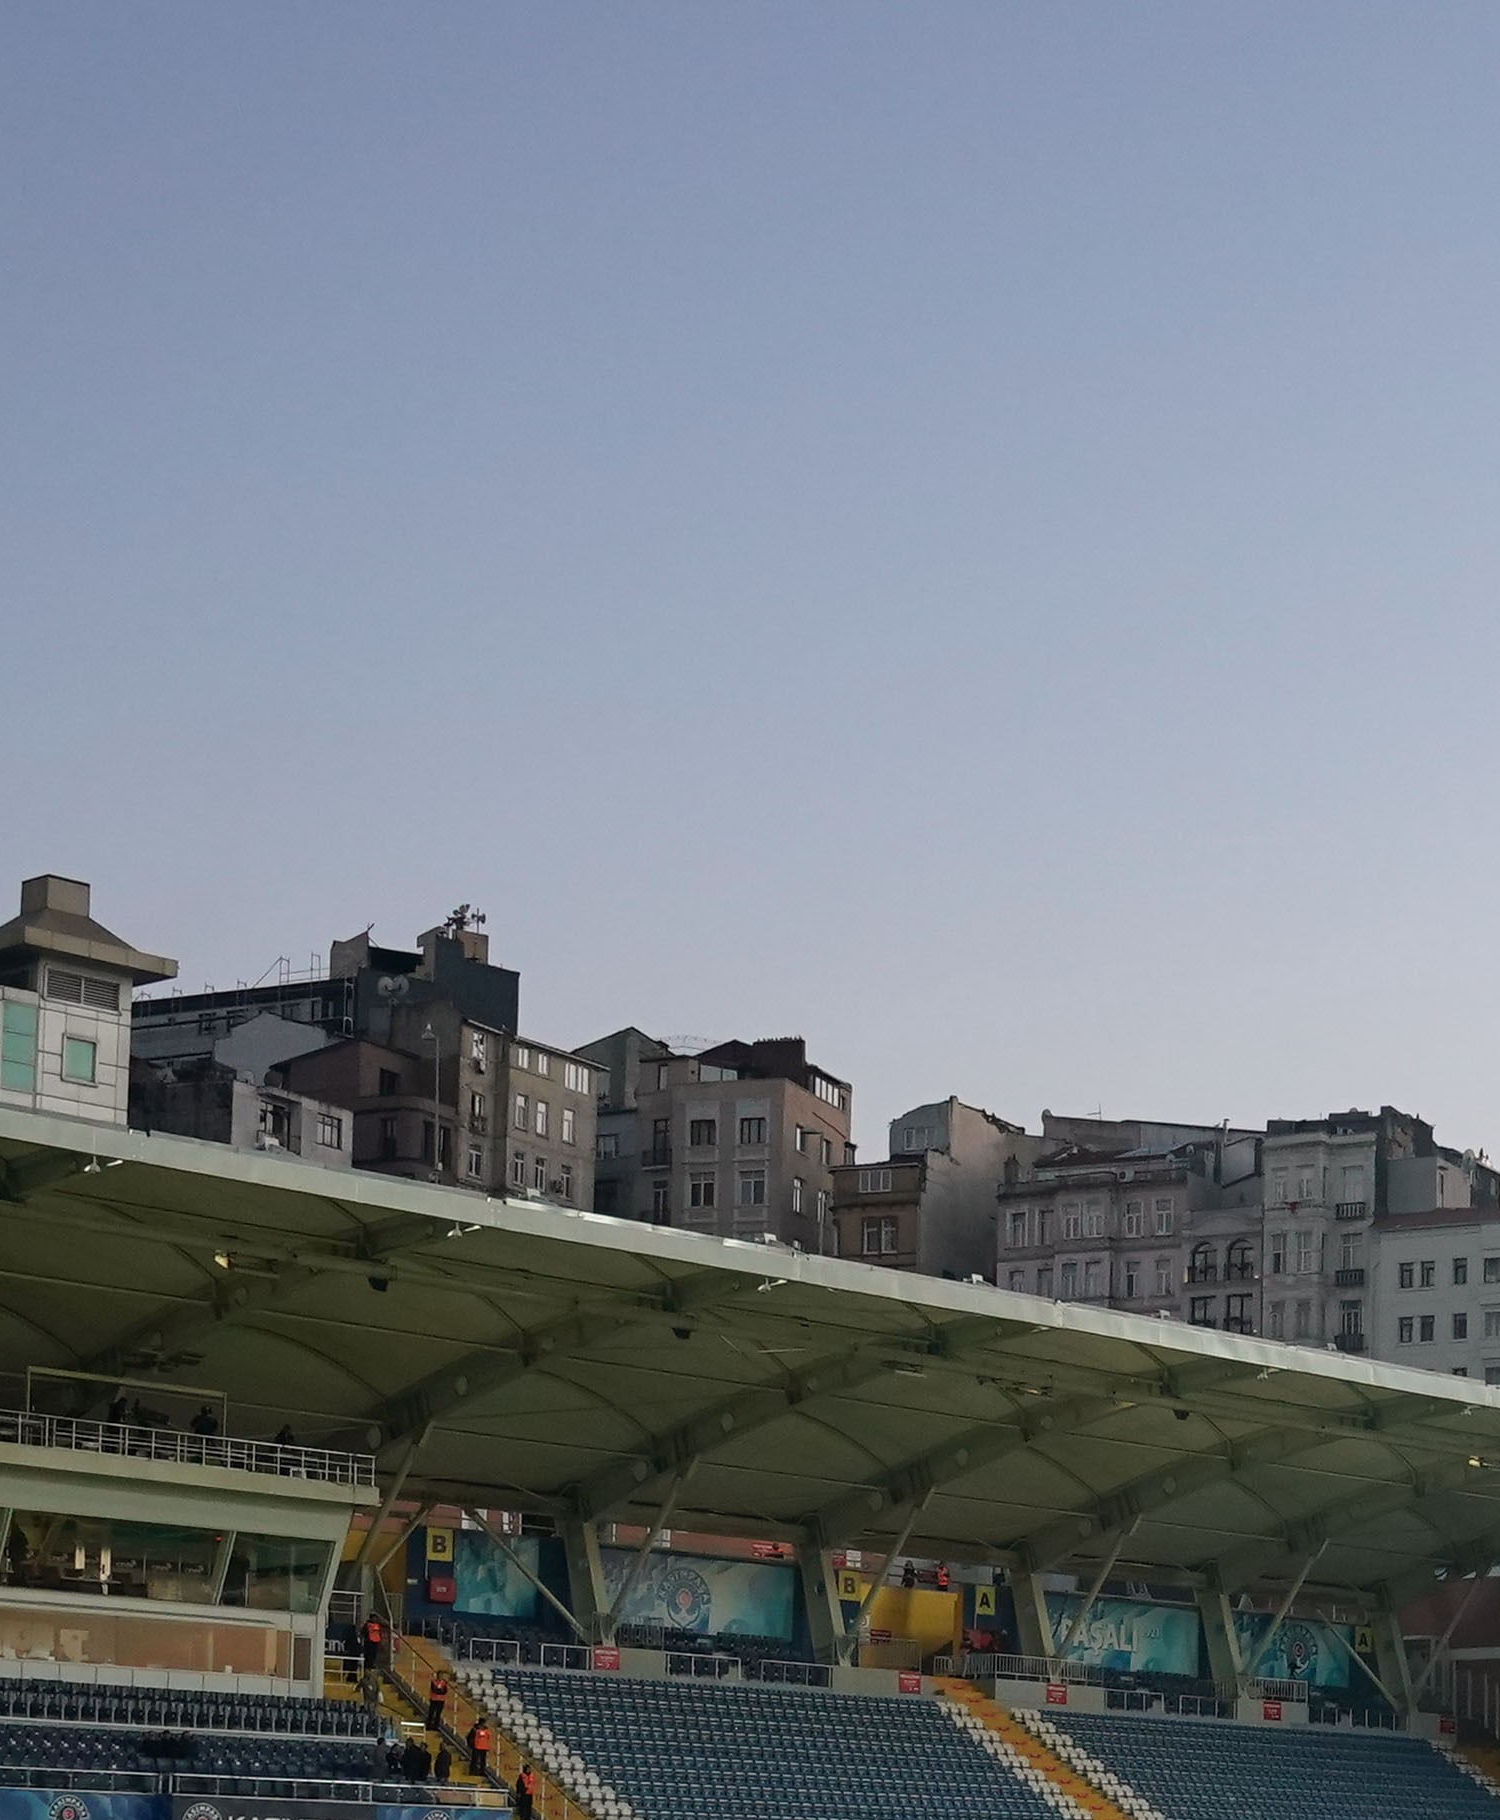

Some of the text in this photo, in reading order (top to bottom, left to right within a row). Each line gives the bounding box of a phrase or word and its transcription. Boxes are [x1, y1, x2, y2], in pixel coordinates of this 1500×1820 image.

[432, 1535, 447, 1553] B
[843, 1577, 856, 1595] B
[979, 1593, 991, 1610] A
[1357, 1631, 1370, 1648] A
